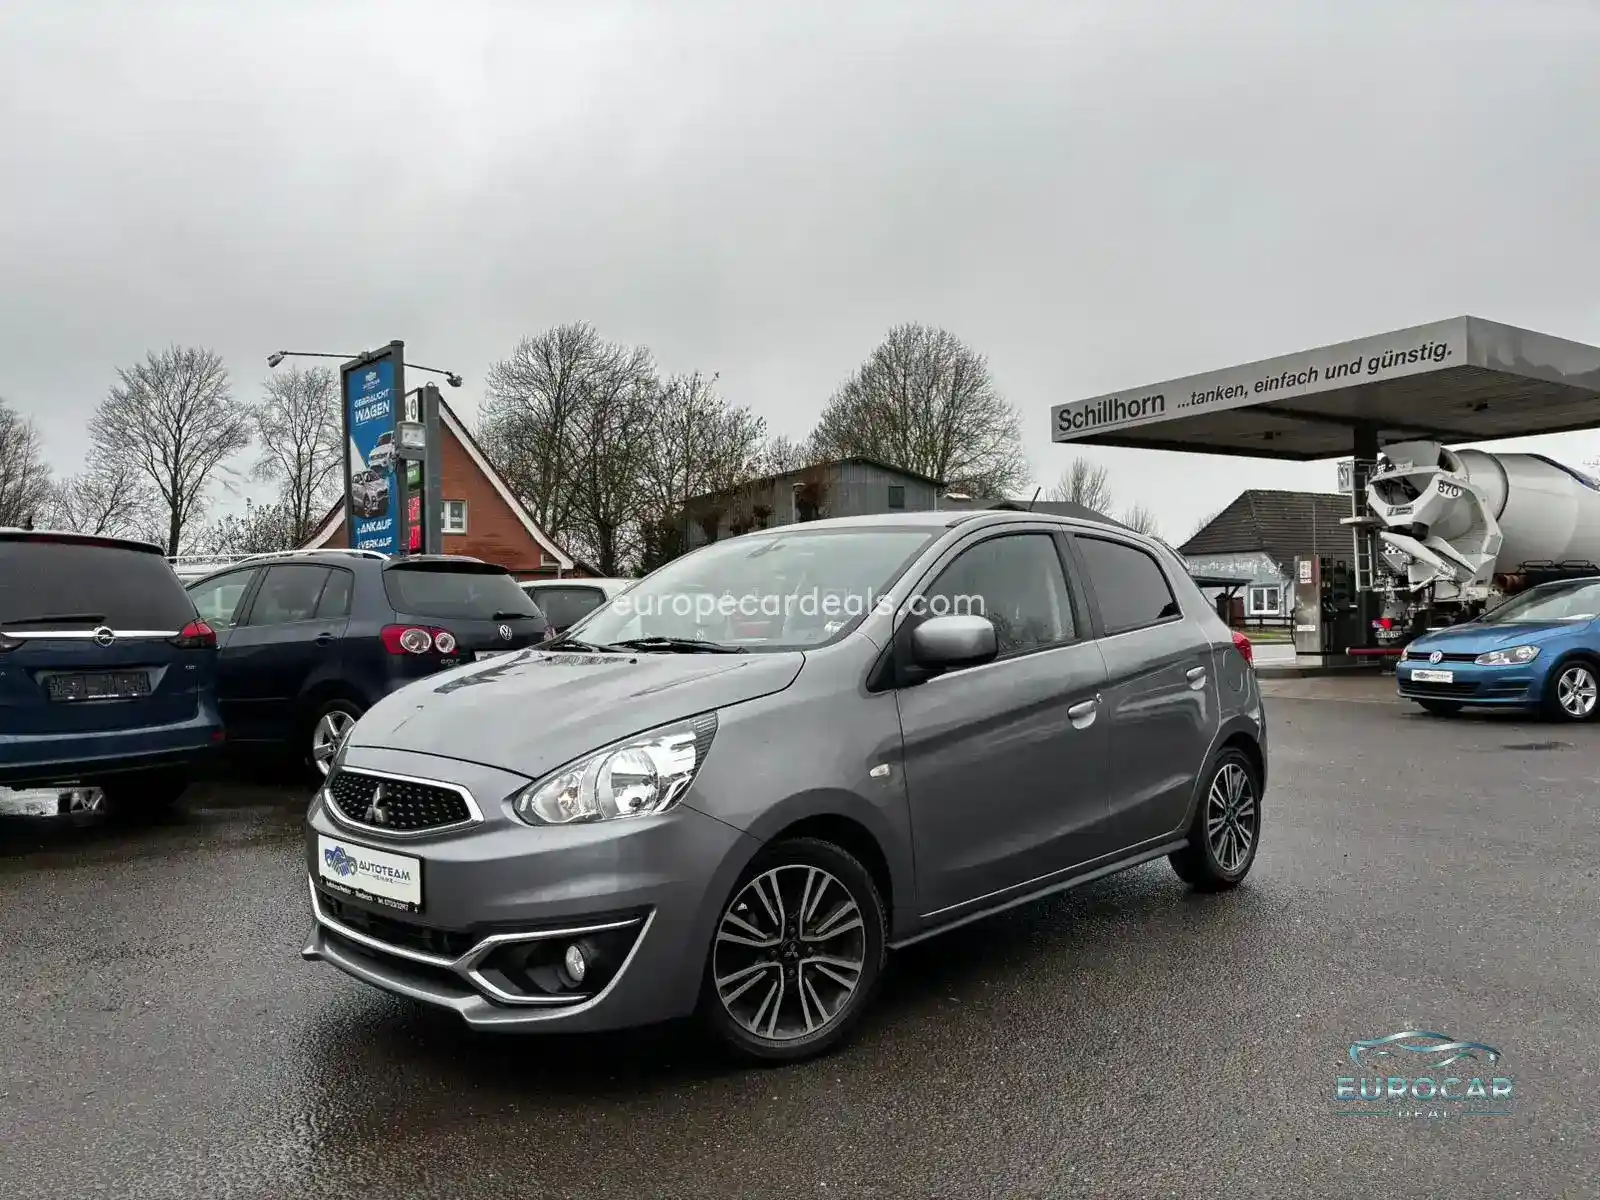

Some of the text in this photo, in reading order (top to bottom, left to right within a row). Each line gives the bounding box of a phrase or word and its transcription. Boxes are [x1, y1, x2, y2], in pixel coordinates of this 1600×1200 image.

[1058, 341, 1453, 432] Schillhorn ...tanken, einfach und günstig.
[354, 388, 391, 408] GEBRAUCHT
[354, 400, 390, 423] WAGEN
[1437, 480, 1460, 498] 870
[359, 860, 411, 881] AUTOTEAM
